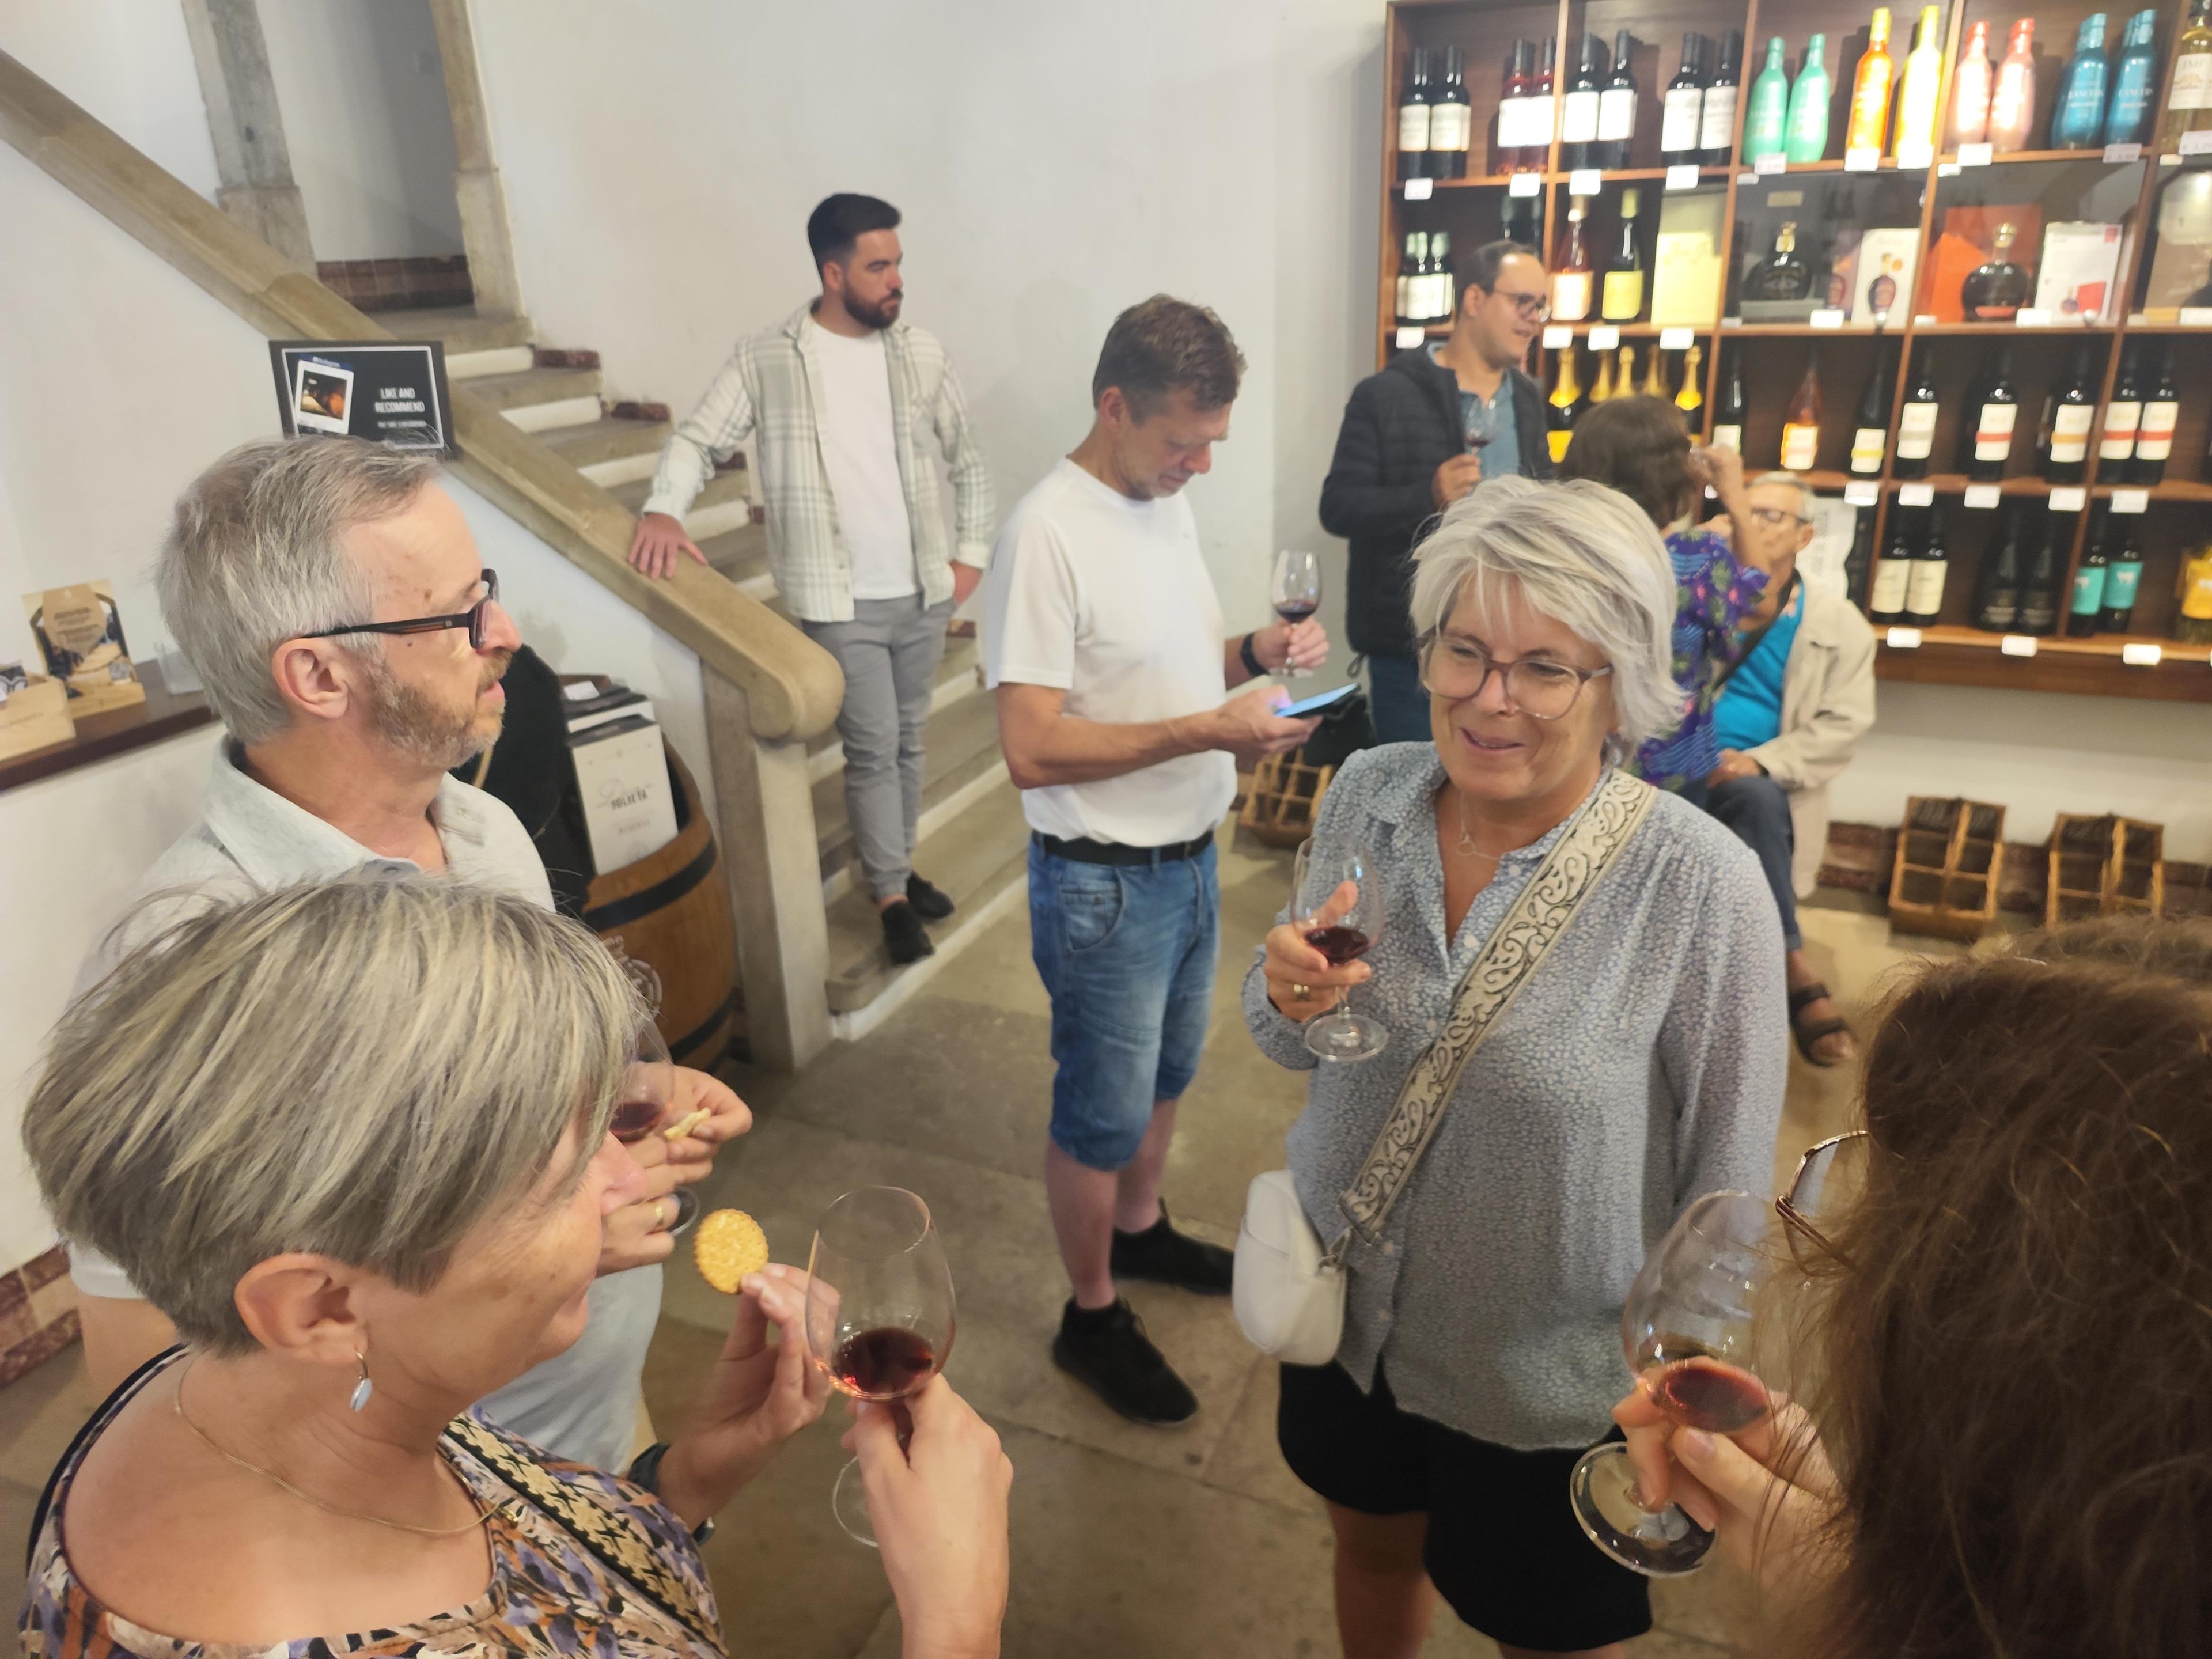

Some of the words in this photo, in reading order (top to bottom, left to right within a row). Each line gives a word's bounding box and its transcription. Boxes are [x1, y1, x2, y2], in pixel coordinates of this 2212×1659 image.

[380, 387, 397, 399] LIKE
[398, 387, 416, 399] AND
[374, 400, 425, 413] RECOMMEND
